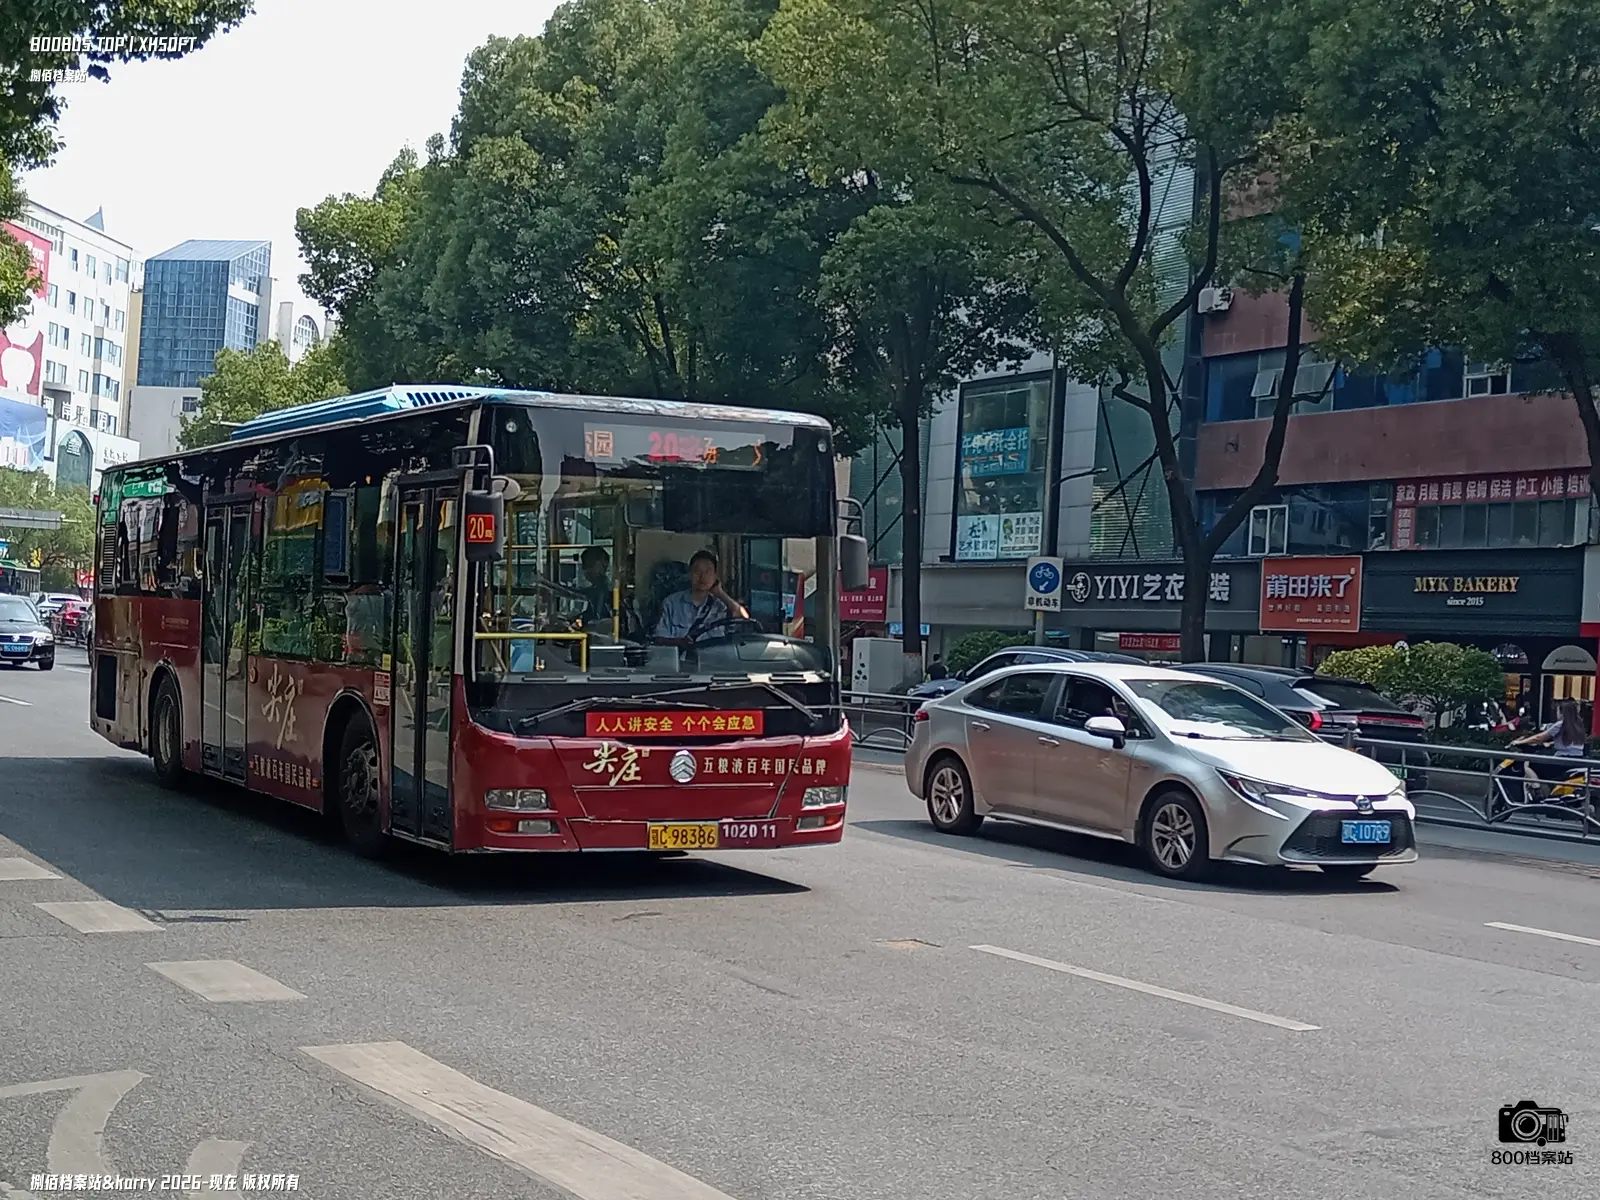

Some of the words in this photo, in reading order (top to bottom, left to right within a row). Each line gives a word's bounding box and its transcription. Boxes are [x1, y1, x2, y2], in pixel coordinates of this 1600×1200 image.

[1396, 484, 1416, 502] 家政
[1419, 482, 1439, 501] 月嫂
[1442, 481, 1463, 500] 育婴
[1466, 480, 1487, 499] 保姆
[1490, 479, 1512, 498] 保洁
[1515, 477, 1538, 497] 护工
[1567, 474, 1591, 493] 培训
[1094, 575, 1140, 599] YIYI
[1142, 573, 1230, 601] 艺衣装
[1265, 573, 1353, 599] 莆田来了
[1413, 576, 1449, 592] MYK
[1452, 576, 1519, 593] BAKERY
[1446, 596, 1466, 606] since
[1466, 597, 1484, 606] 2015
[596, 717, 673, 732] 人人讲安全
[682, 715, 756, 731] 个个会应急
[703, 756, 827, 775] 五粮液百年国民品牌
[722, 824, 757, 838] 1020
[761, 824, 777, 838] 11
